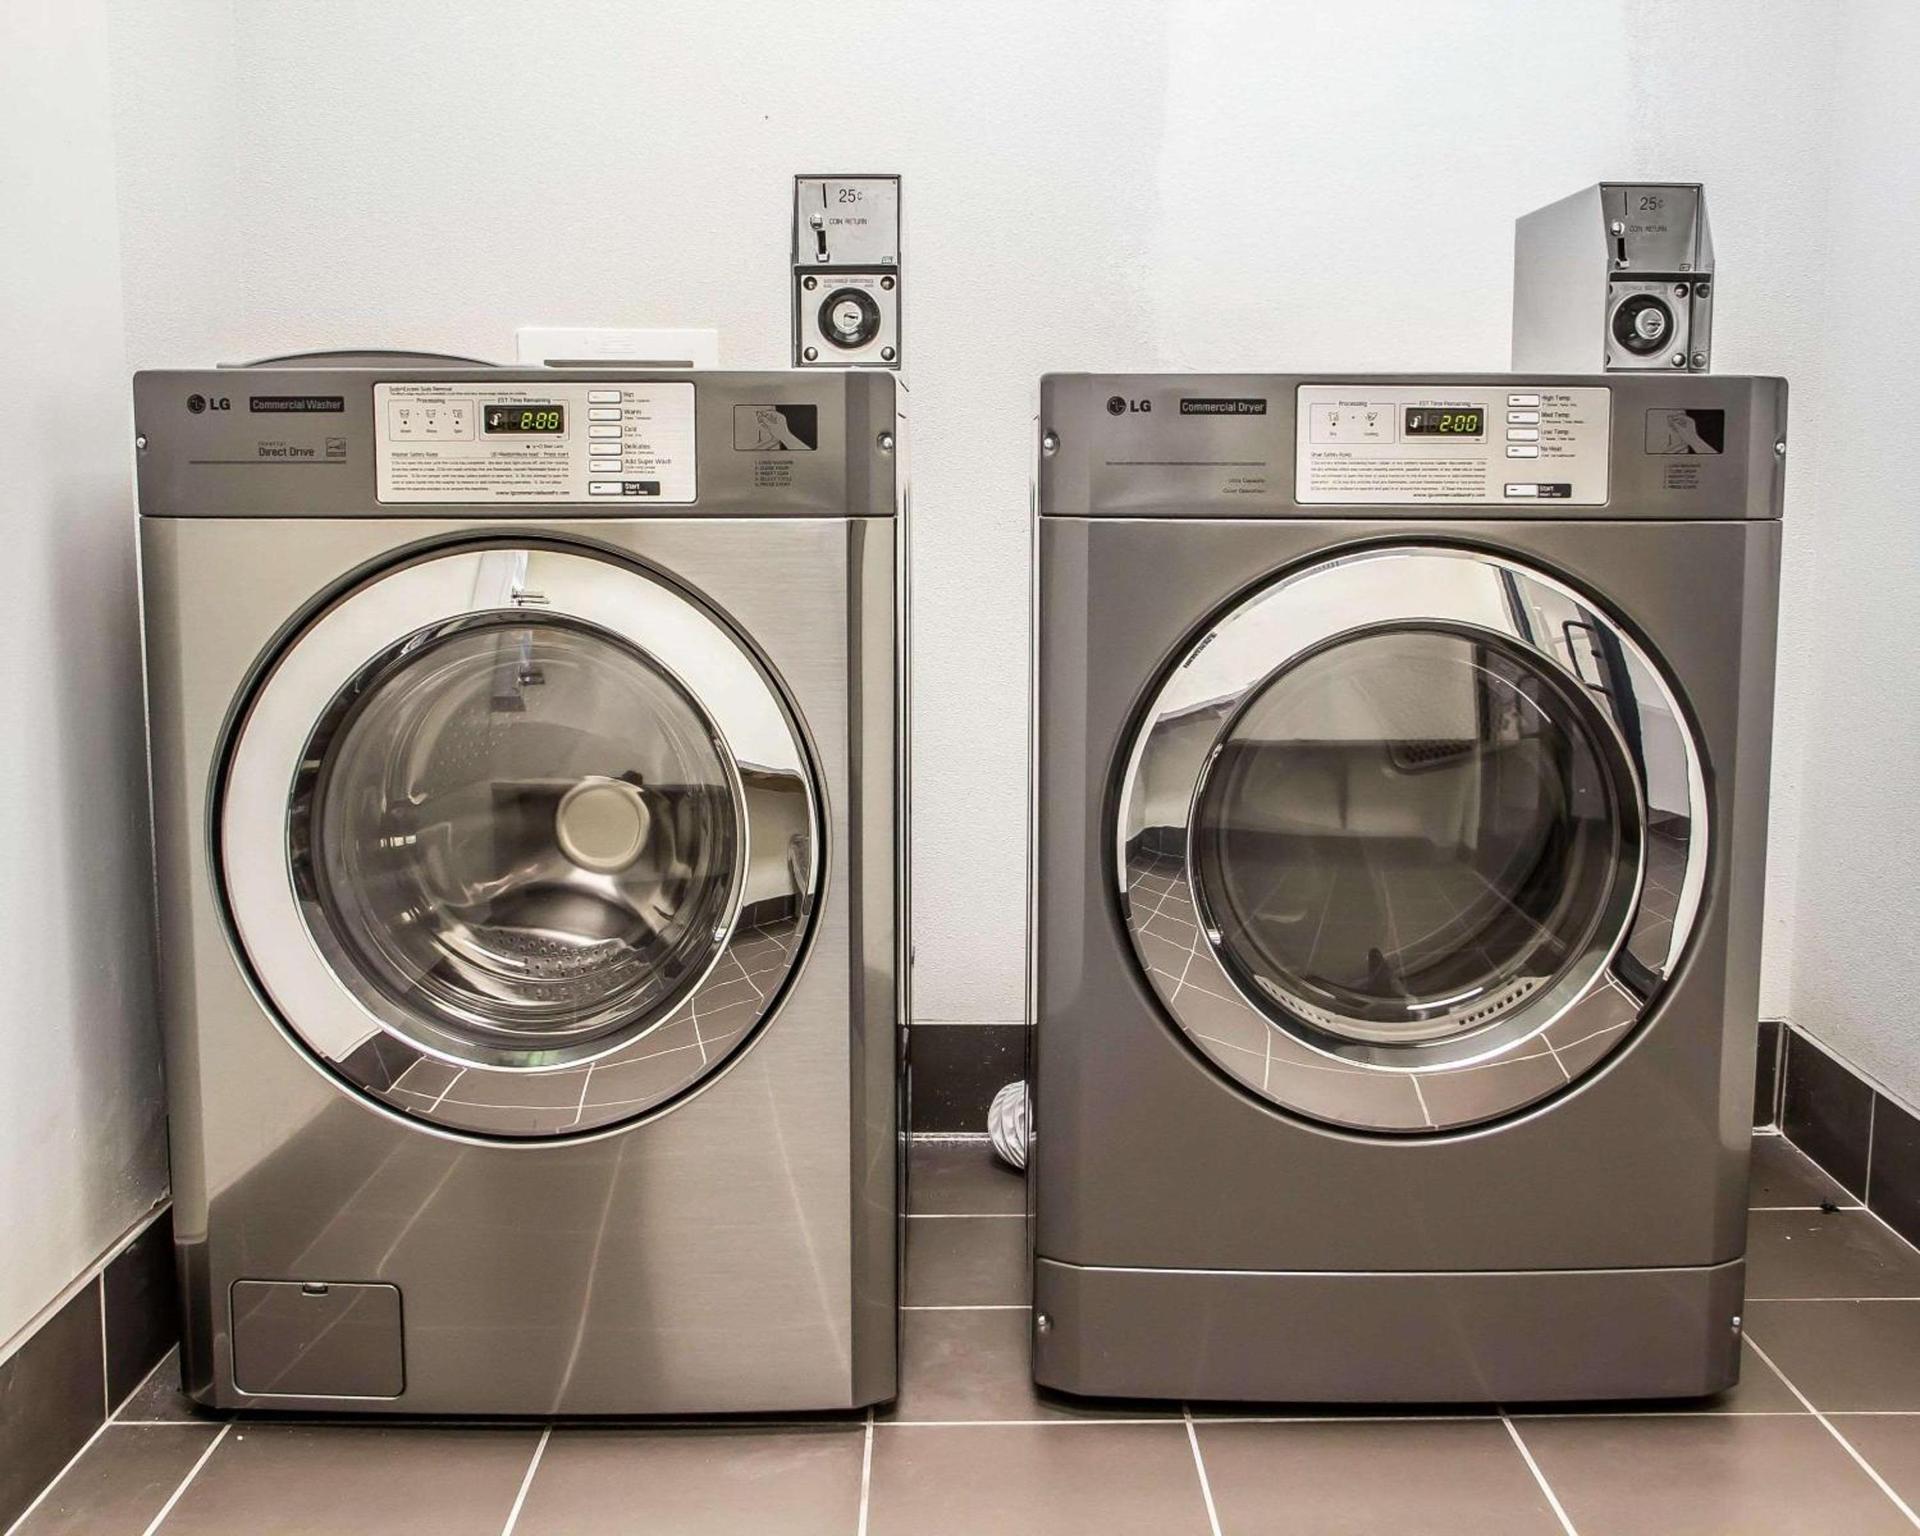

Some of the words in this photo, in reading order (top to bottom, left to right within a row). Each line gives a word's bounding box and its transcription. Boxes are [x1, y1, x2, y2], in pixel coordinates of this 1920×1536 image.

[252, 400, 305, 410] Commercial
[306, 400, 342, 410] Washer
[1182, 402, 1236, 412] Commercial
[1238, 402, 1265, 413] Dryer
[258, 447, 287, 457] Direct
[289, 447, 315, 457] Drive
